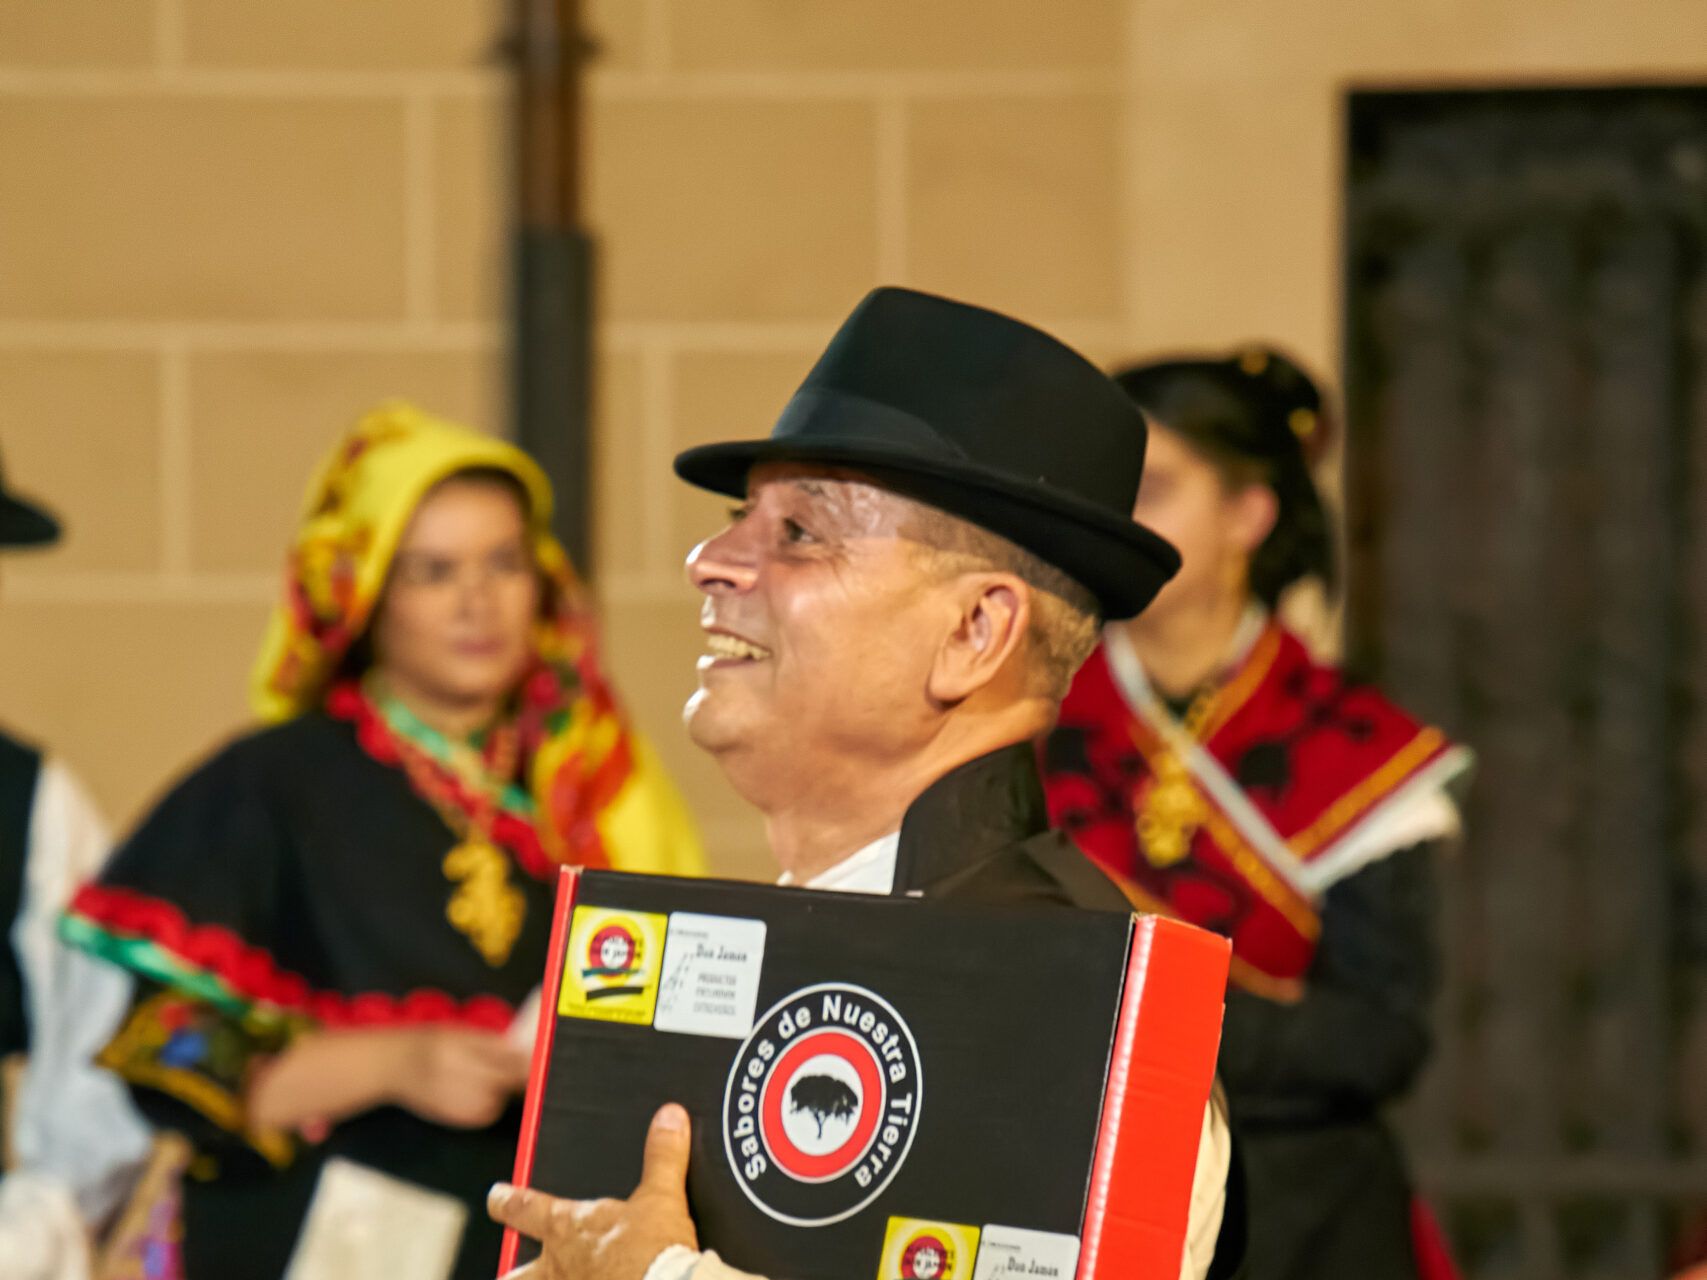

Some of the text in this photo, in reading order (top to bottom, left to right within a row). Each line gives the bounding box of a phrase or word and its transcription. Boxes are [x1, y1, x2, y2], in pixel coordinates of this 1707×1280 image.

[733, 994, 912, 1188] Sabores de Nuestra Tierra
